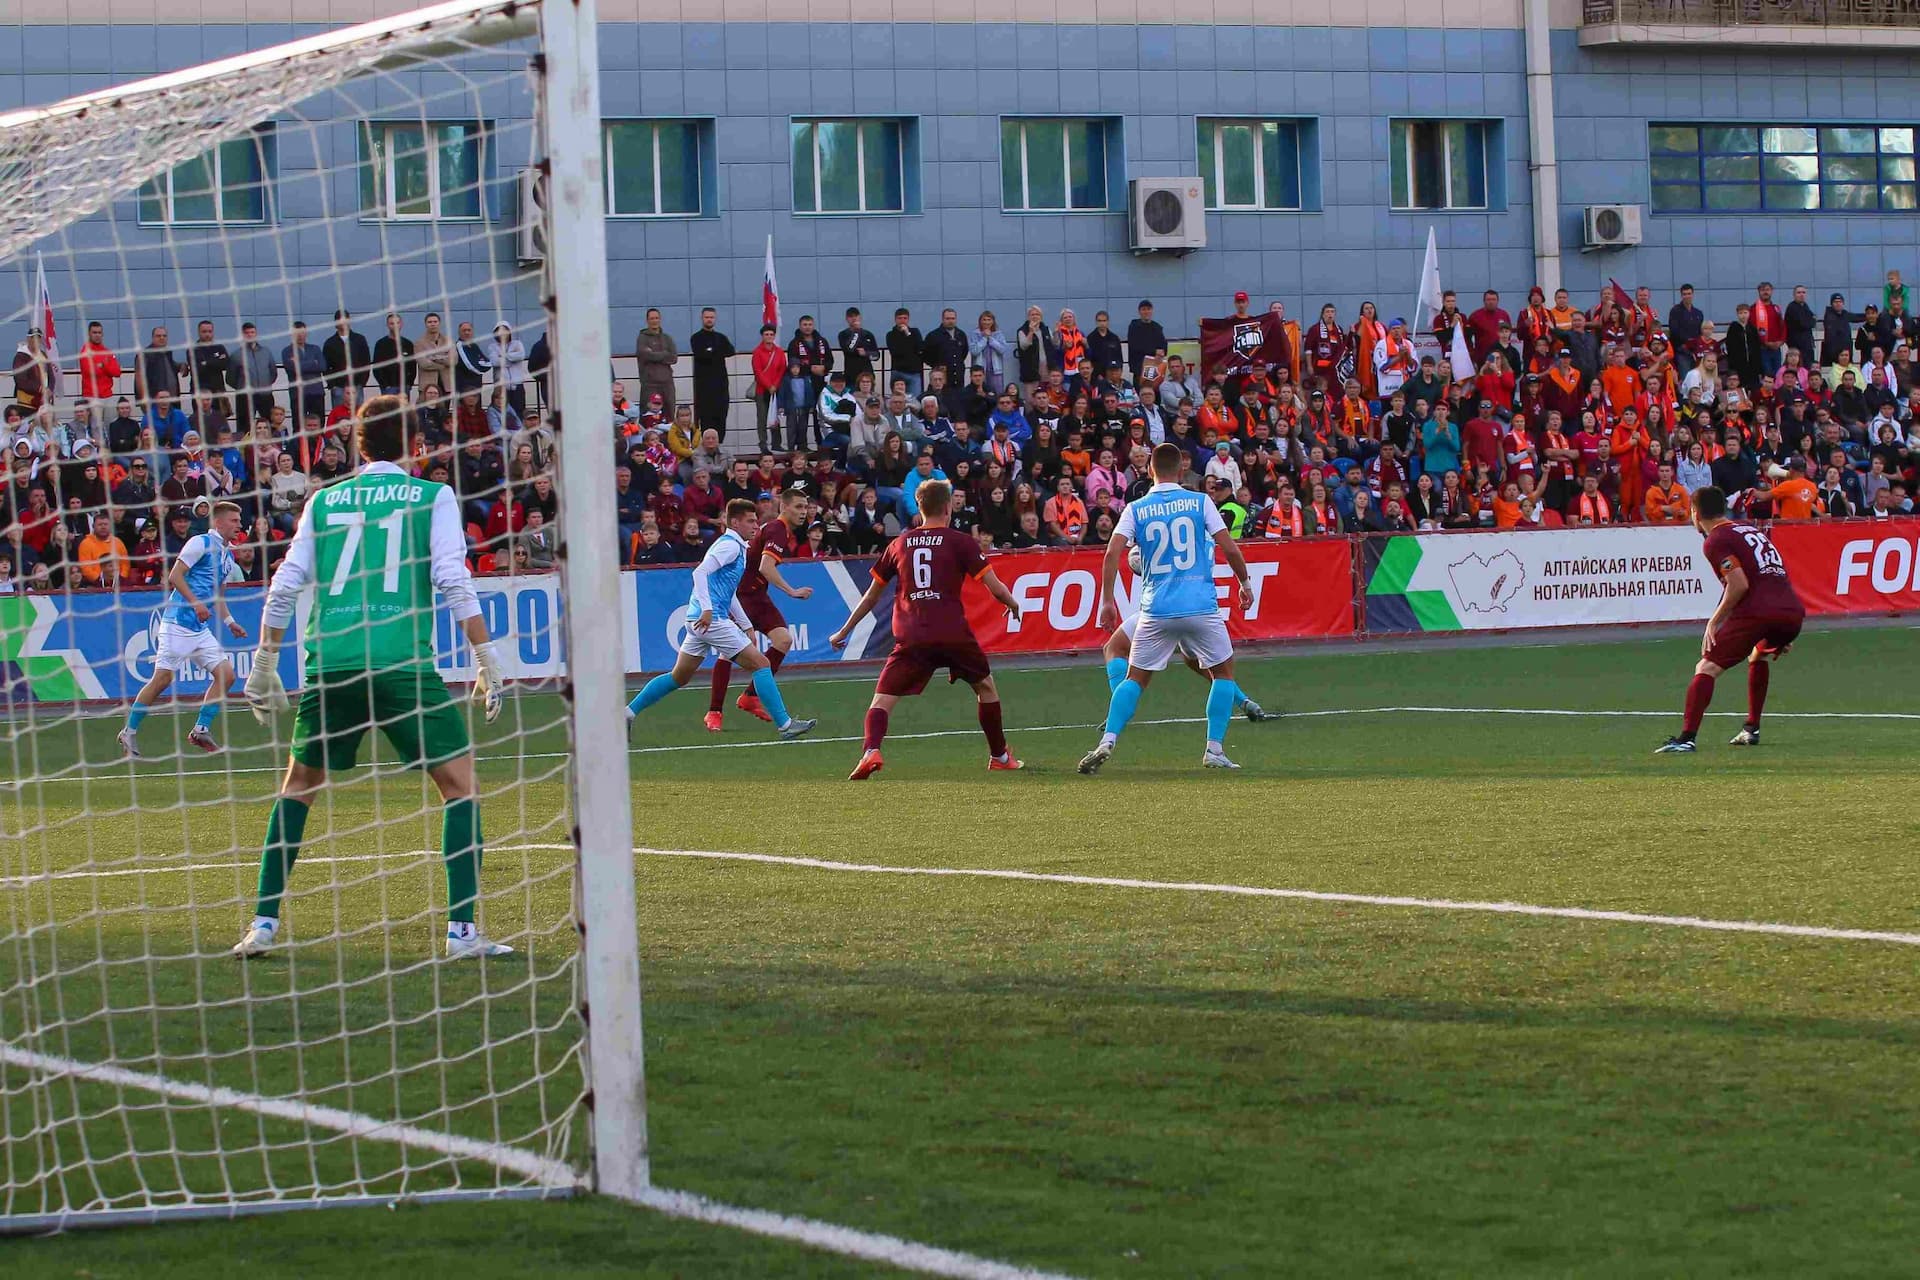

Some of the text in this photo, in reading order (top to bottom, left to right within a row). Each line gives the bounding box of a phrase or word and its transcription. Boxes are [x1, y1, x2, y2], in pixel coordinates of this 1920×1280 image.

[325, 484, 423, 507] ФАТТАХОВ
[1137, 499, 1200, 521] ИГНАТОВИЧ
[327, 508, 404, 595] 71
[906, 535, 944, 548] КНЯЗЕВ
[1146, 516, 1196, 575] 29
[913, 547, 932, 588] 6
[1543, 555, 1692, 577] АЛТАЙСКАЯ КРАЕВАЯ
[1836, 536, 1920, 595] FO
[1006, 561, 1279, 633] FONET
[1533, 578, 1703, 601] НОТАРИАЛЬНАЯ ПАЛАТА
